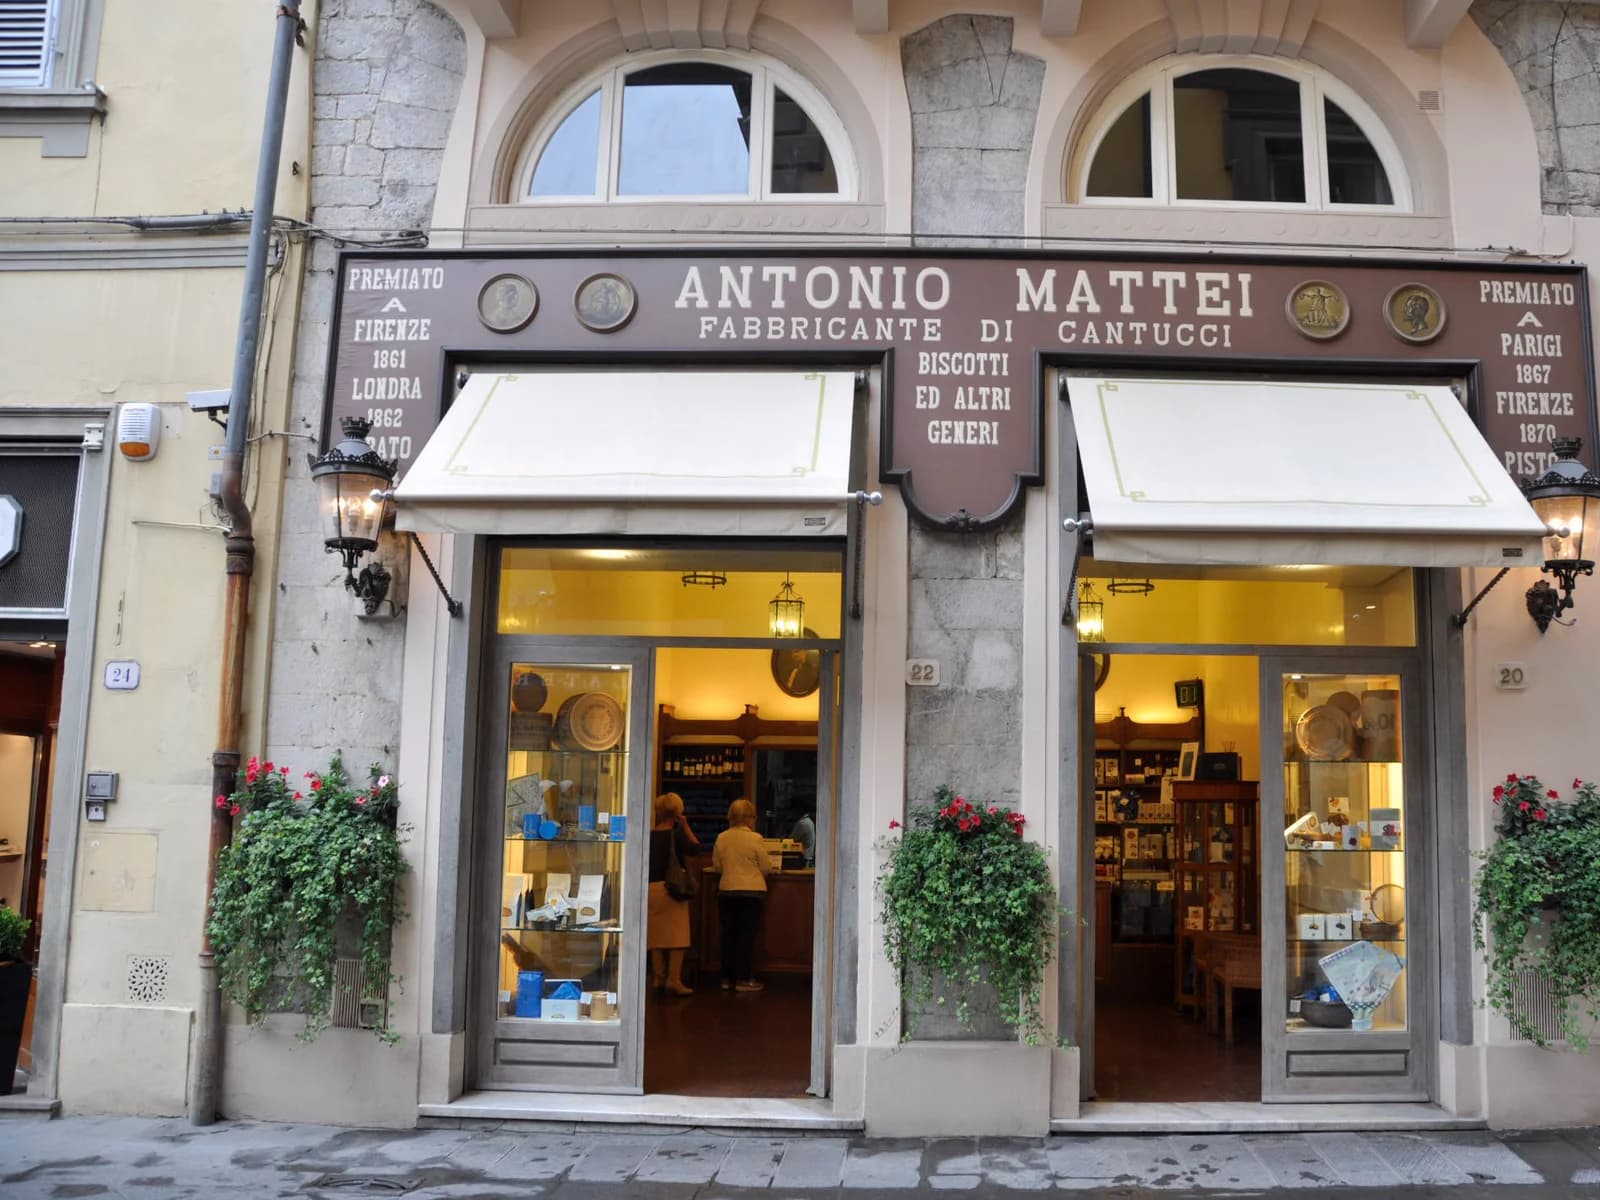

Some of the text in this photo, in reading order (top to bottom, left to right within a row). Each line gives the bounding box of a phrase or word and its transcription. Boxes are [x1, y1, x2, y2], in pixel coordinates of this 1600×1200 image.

[349, 267, 444, 290] PREMIATO
[674, 266, 1253, 317] ANTONIO MATTEI
[1479, 280, 1575, 305] PREMIATO
[380, 297, 407, 313] A
[353, 318, 431, 342] FIRENZE
[1516, 311, 1543, 328] A
[698, 316, 1231, 348] FABBRICANTE DI CANTUCCI
[1500, 333, 1563, 357] PARIGI
[373, 350, 406, 369] 1861
[918, 352, 1009, 376] BISCOTTI
[1516, 364, 1551, 384] 1867
[351, 376, 422, 401] LONDRA
[915, 386, 1011, 411] ED ALTRI
[1495, 392, 1574, 416] FIRENZE
[367, 408, 403, 428] 1862
[927, 420, 999, 445] GENERI
[1519, 423, 1556, 444] 1870
[911, 664, 934, 681] 22
[1500, 668, 1524, 684] 20
